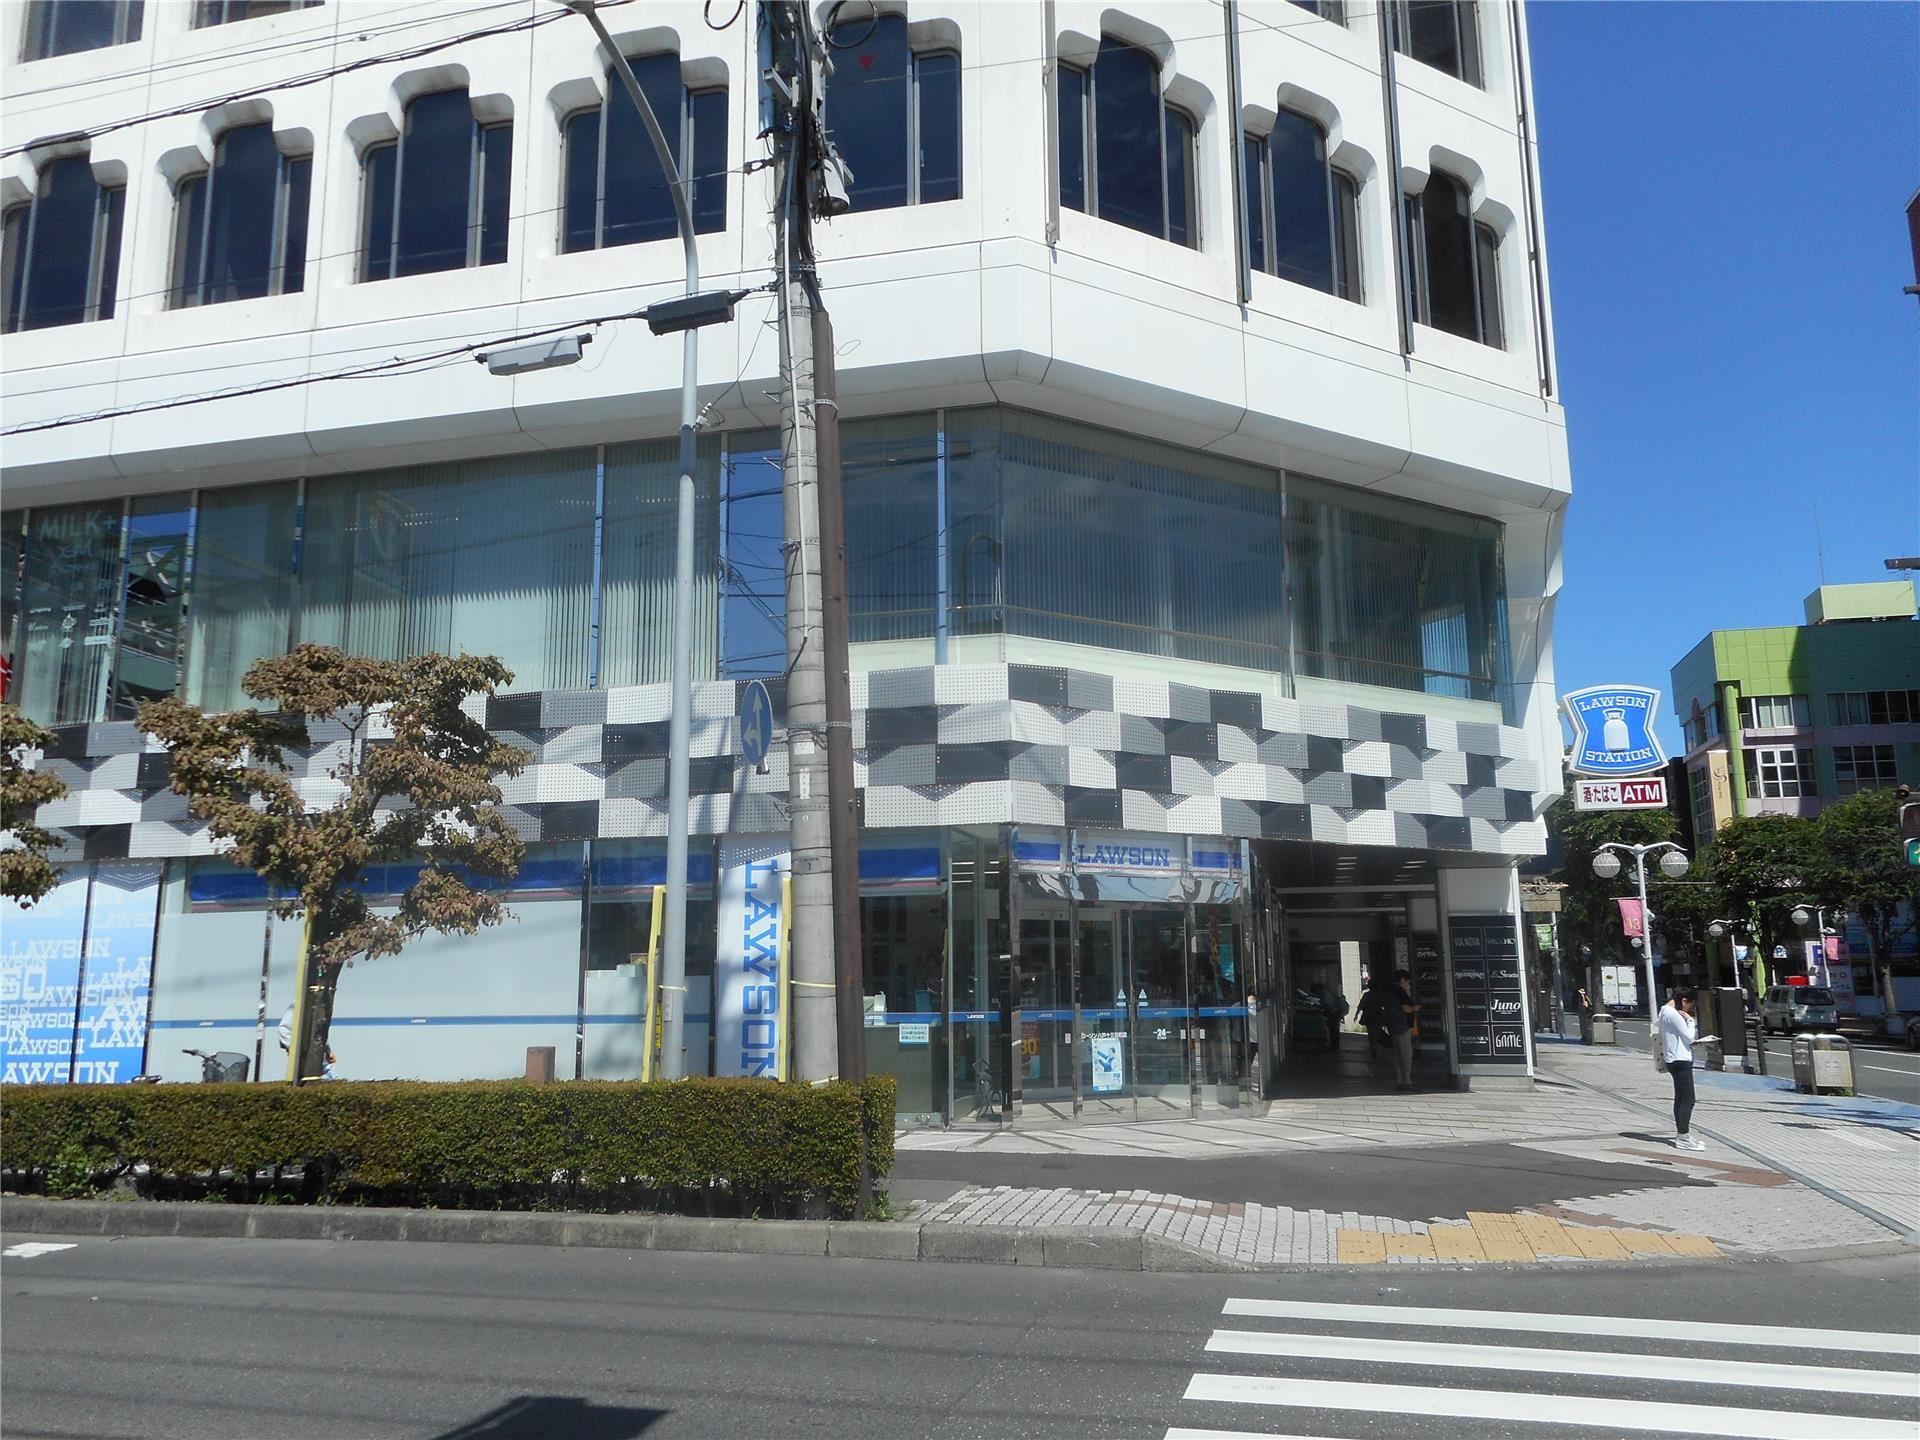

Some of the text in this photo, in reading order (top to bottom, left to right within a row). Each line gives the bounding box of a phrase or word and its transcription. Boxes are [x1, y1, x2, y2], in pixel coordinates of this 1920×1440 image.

[1579, 695, 1648, 712] LAWSON
[1585, 748, 1654, 763] STATION
[1624, 784, 1660, 802] ATM
[1077, 844, 1170, 867] LAWSON
[1491, 999, 1521, 1011] Juno
